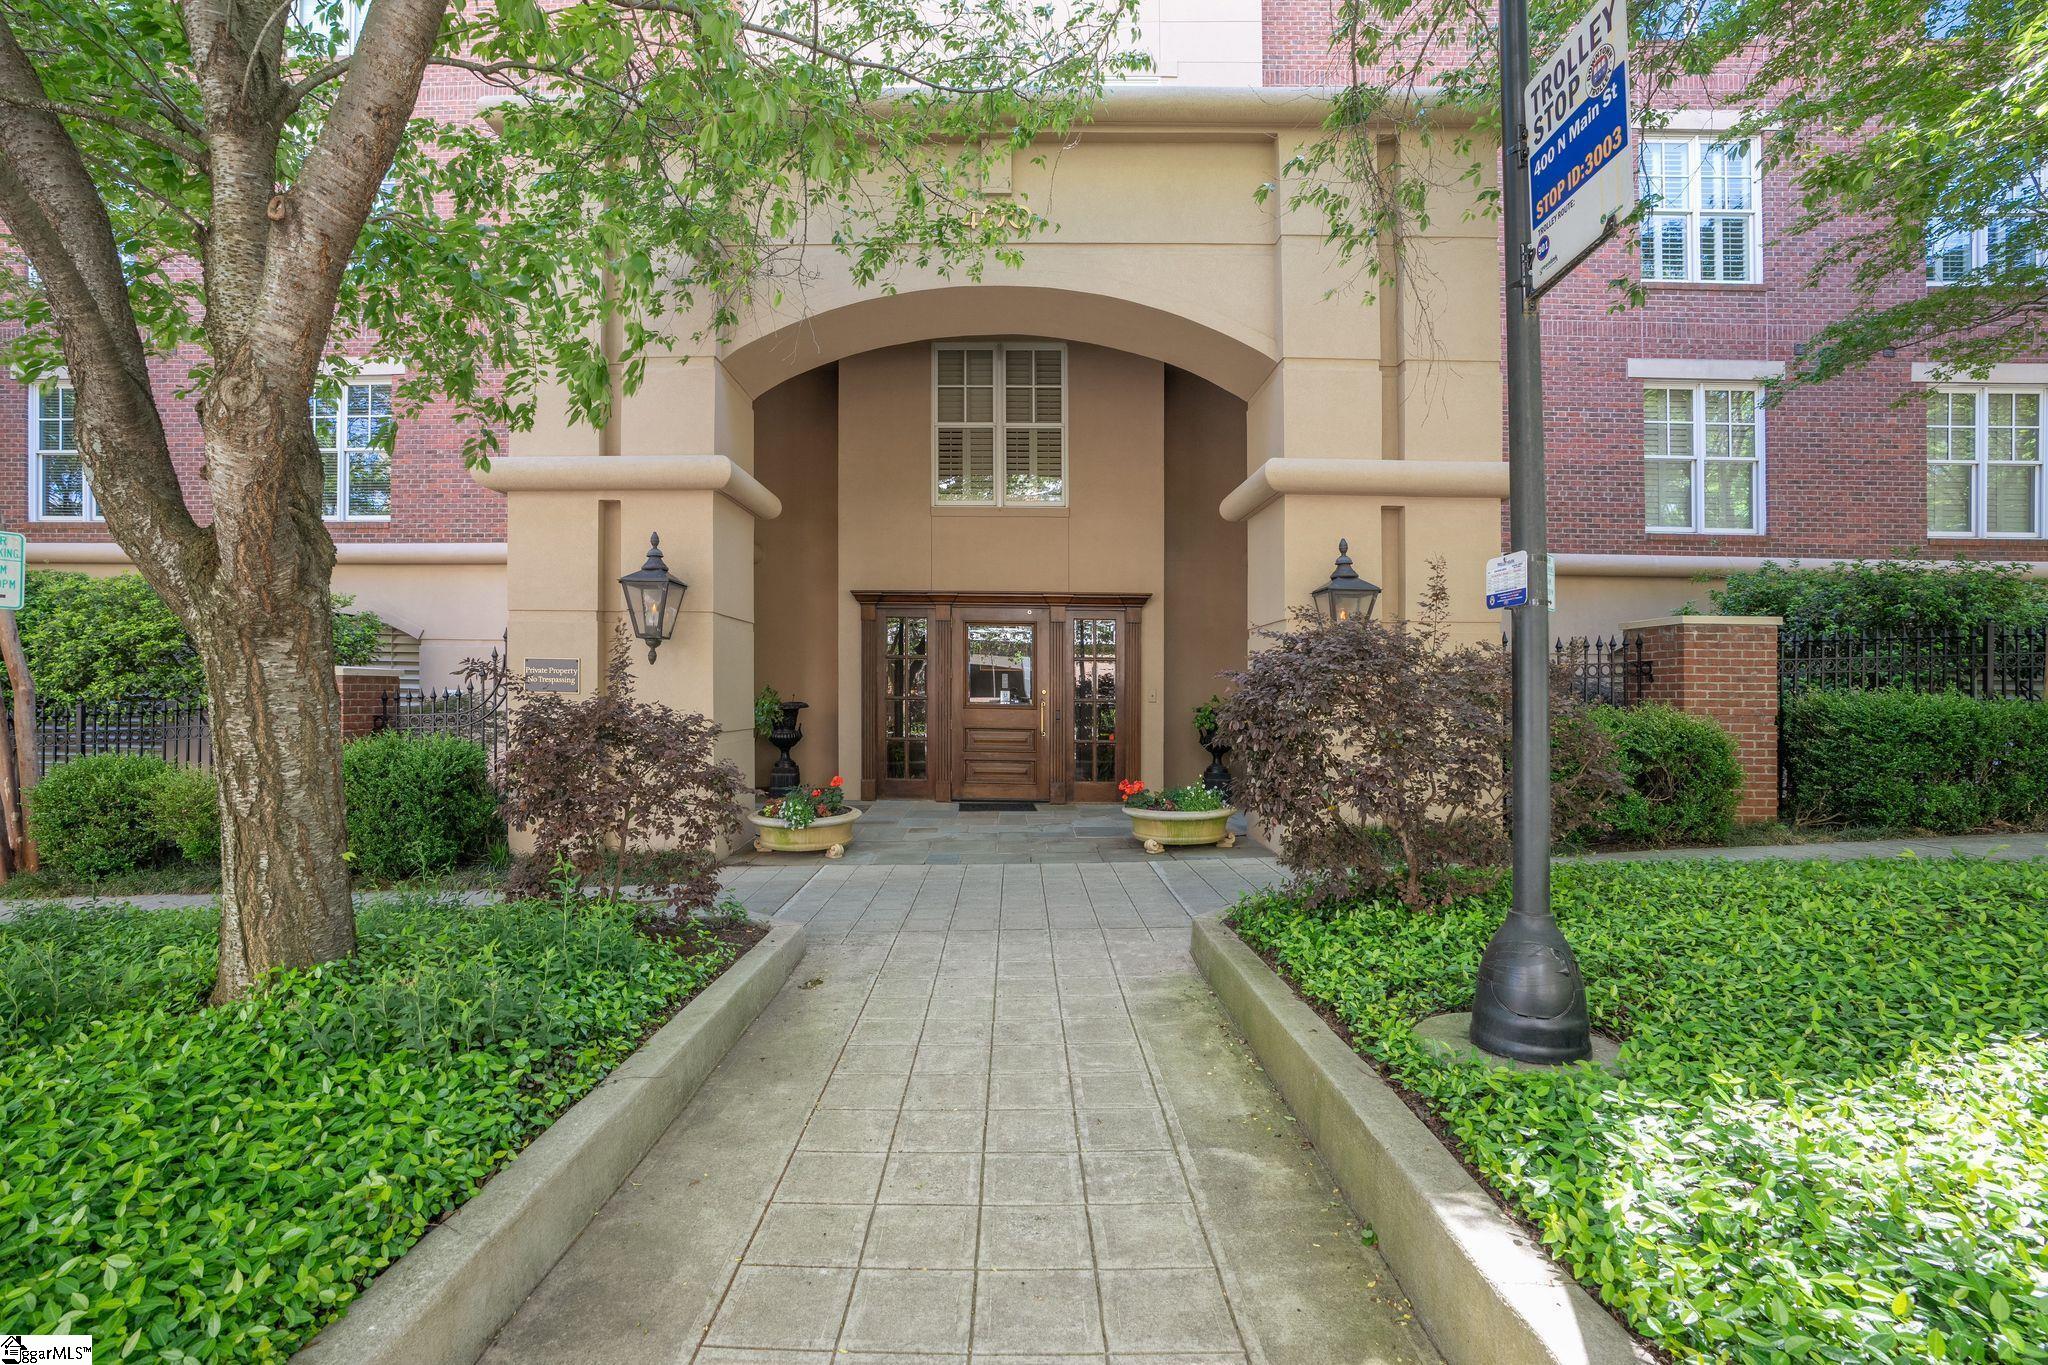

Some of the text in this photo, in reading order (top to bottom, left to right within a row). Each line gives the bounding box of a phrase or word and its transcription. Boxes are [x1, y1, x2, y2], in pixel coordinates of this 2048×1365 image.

[1530, 0, 1615, 115] TROLLEY
[1533, 74, 1580, 145] STOP
[1533, 81, 1618, 176] 400 N Main St
[1536, 179, 1565, 220] STOP
[1537, 199, 1576, 237] TROLLEY ROUTE:
[1538, 242, 1549, 256] 901
[539, 677, 576, 685] Trespassing
[549, 667, 577, 676] Property
